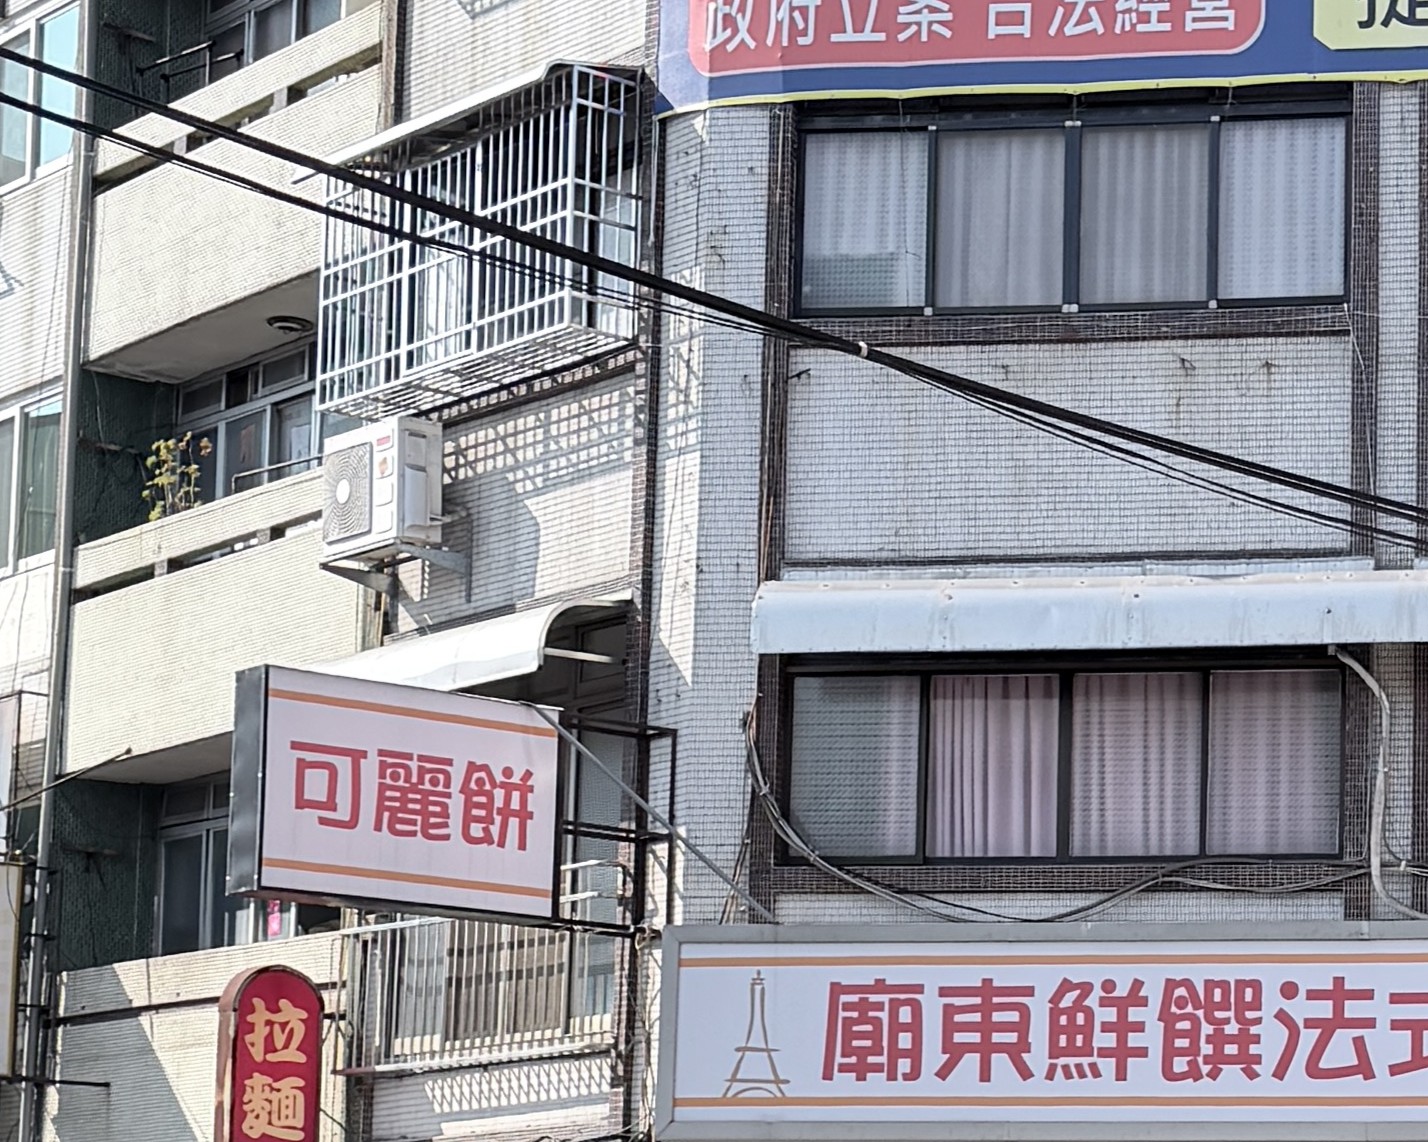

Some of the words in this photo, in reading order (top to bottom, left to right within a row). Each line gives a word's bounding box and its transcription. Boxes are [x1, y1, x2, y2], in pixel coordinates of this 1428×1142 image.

[289, 740, 535, 851] 可麗餅
[241, 996, 309, 1142] 拉麵
